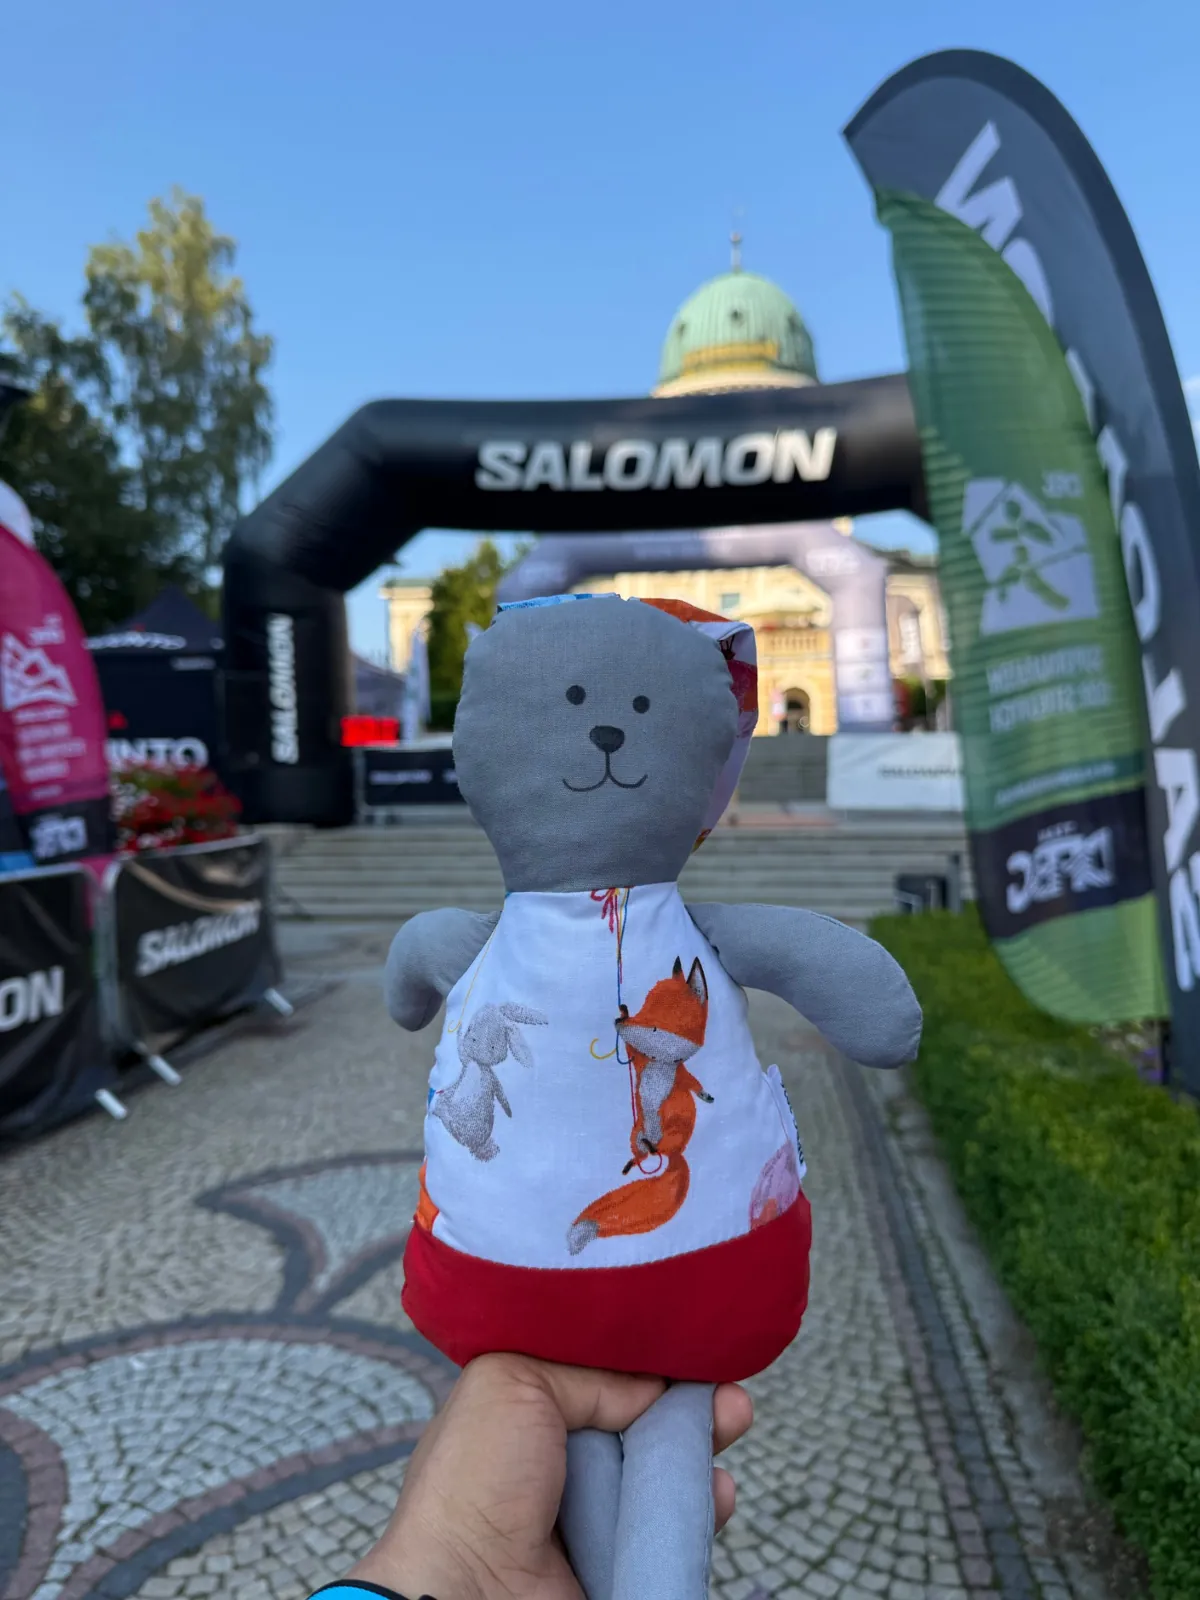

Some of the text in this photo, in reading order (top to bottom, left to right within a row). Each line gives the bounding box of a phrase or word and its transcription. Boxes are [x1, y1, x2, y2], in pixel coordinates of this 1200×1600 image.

[475, 427, 838, 492] SALOMON
[267, 613, 299, 764] SALOMON
[136, 902, 261, 977] SALOMON
